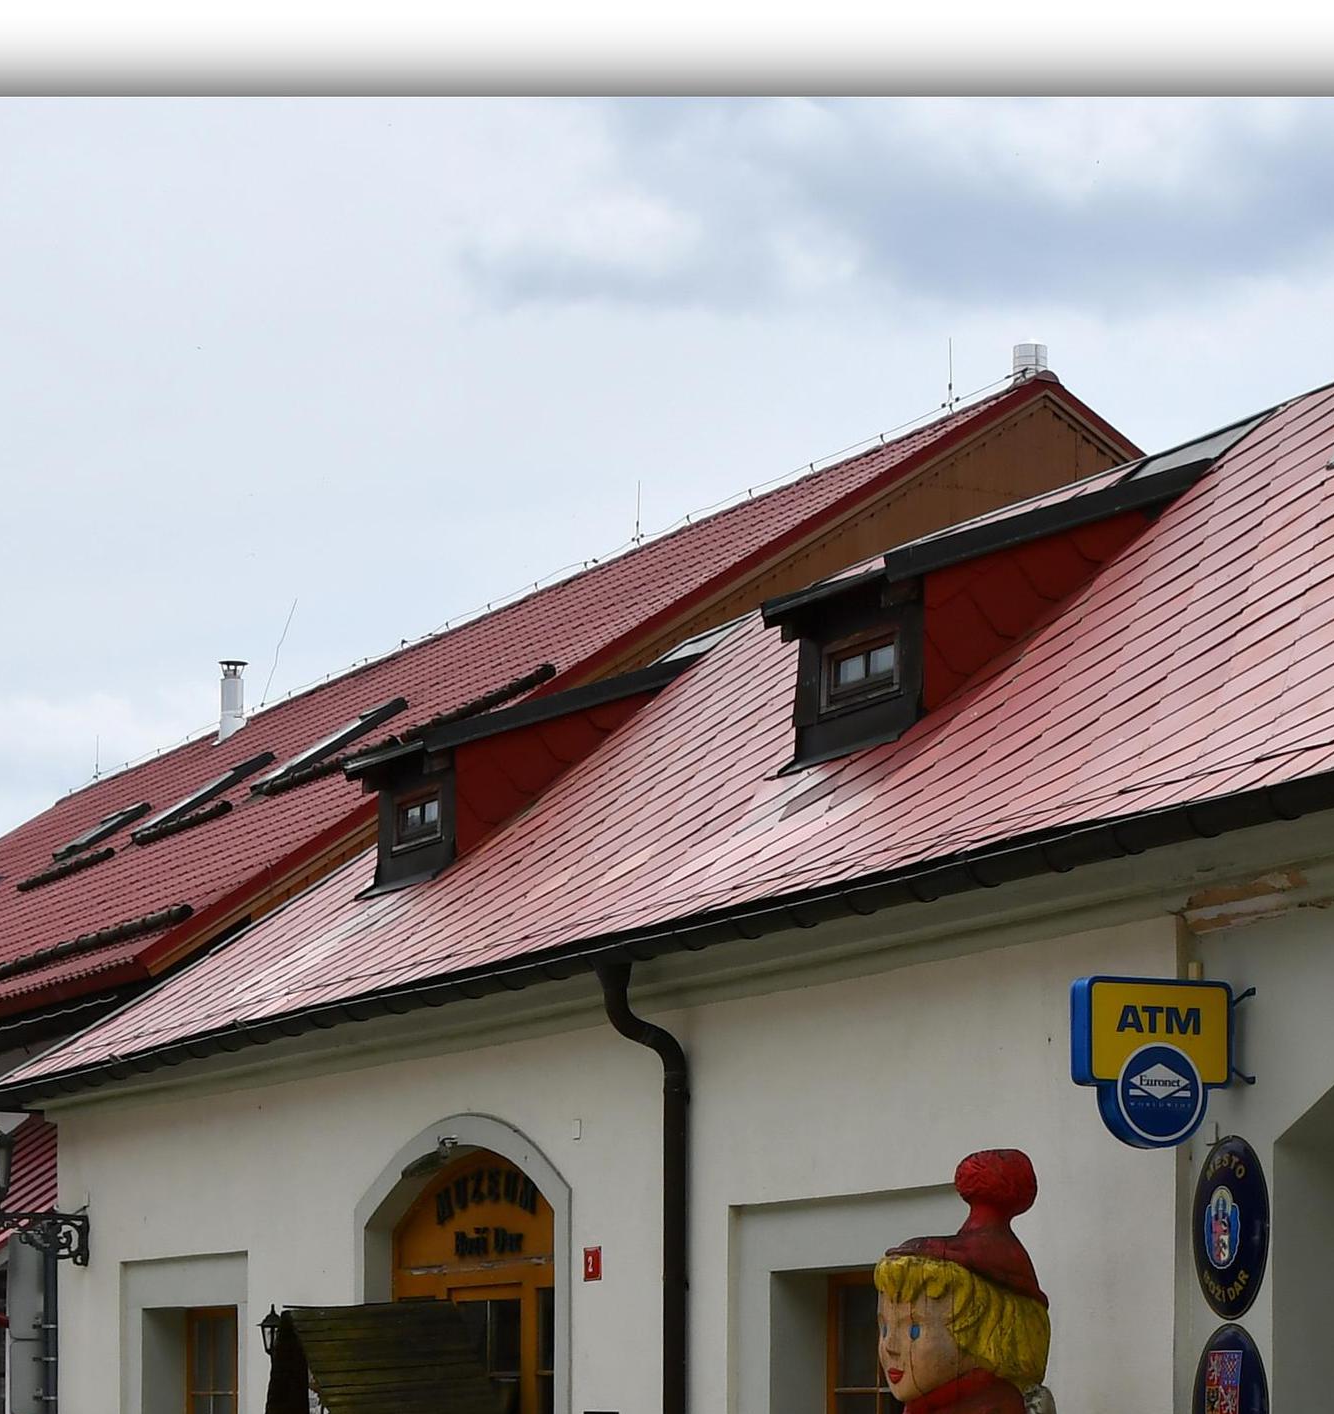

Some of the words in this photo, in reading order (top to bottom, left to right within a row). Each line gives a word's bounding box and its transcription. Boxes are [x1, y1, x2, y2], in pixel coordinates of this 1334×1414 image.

[1116, 1004, 1202, 1035] ATM
[1139, 1074, 1182, 1088] Euronet
[435, 1168, 538, 1225] MUZEUM
[587, 1255, 594, 1273] 2
[1226, 1269, 1250, 1302] DAR
